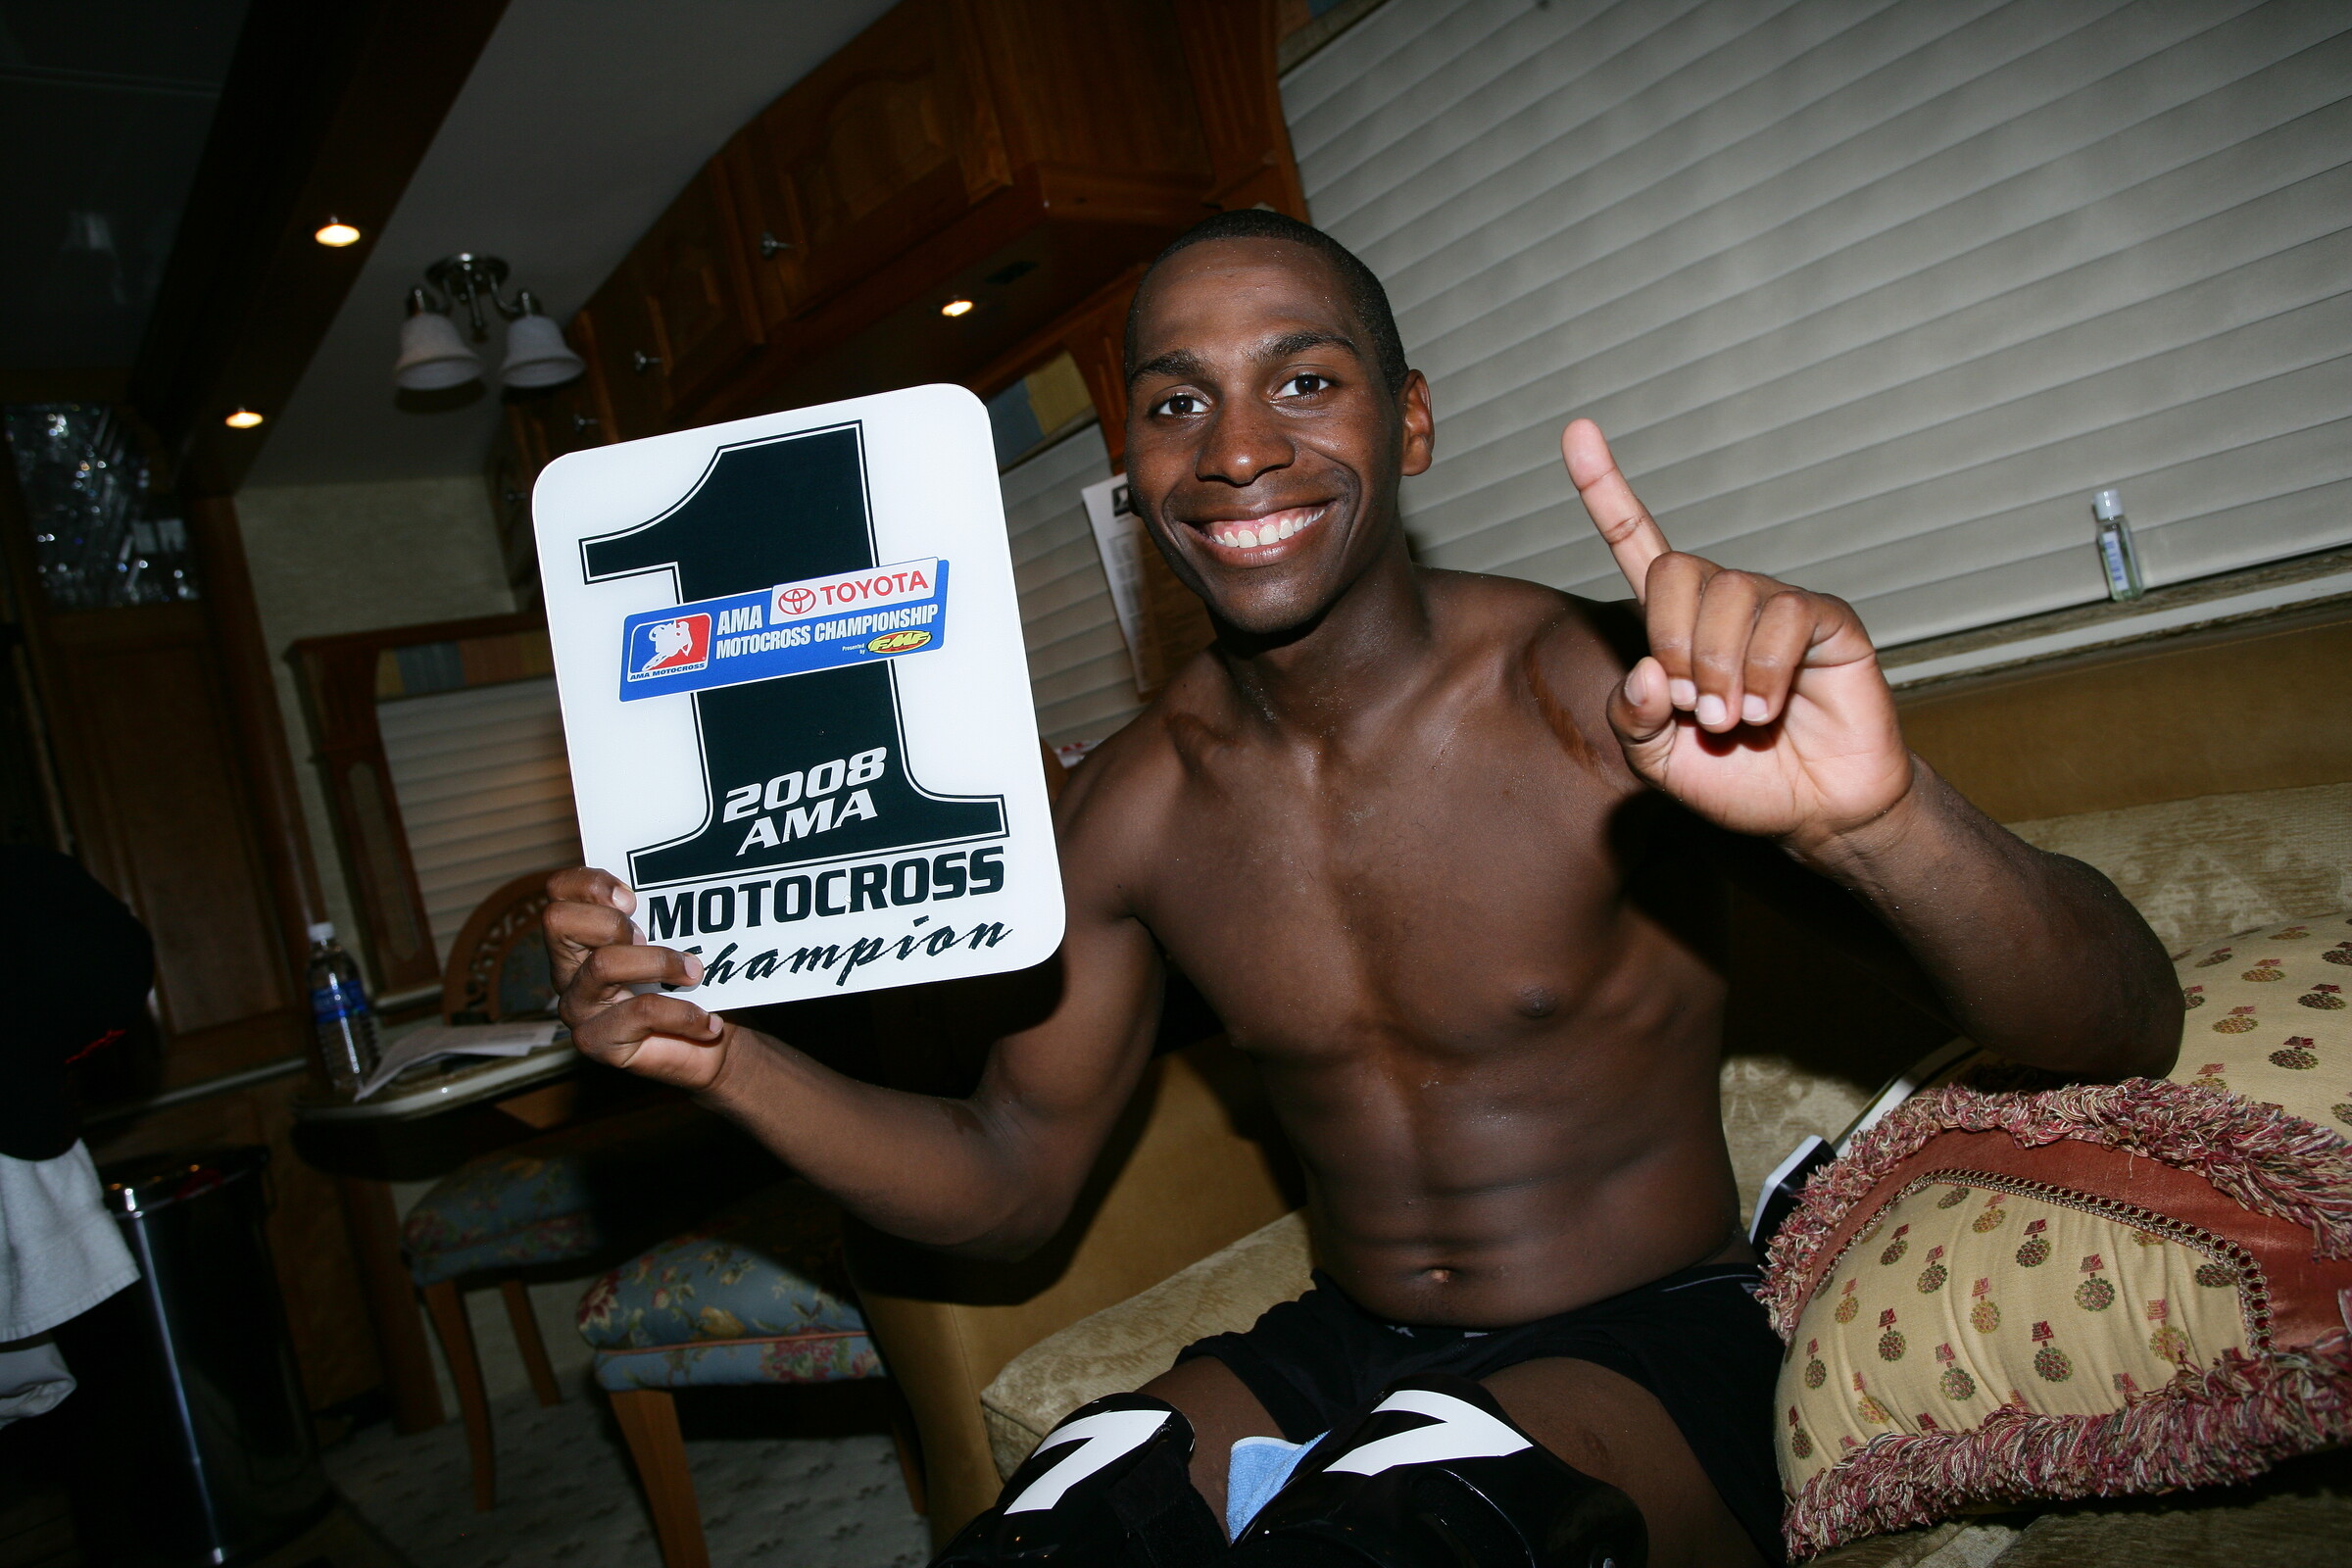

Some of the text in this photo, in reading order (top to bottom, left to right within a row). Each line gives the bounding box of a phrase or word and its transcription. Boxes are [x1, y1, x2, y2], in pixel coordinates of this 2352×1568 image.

[820, 570, 928, 605] TOYOTA
[715, 604, 938, 660] MOTOCROSS CHAMPIONSHIP
[716, 605, 762, 635] AMA
[868, 631, 930, 652] FMF
[653, 663, 705, 675] MOTOCROSS
[722, 747, 888, 823] 2008
[736, 789, 878, 857] AMA
[648, 846, 1004, 942] MOTOCROSS
